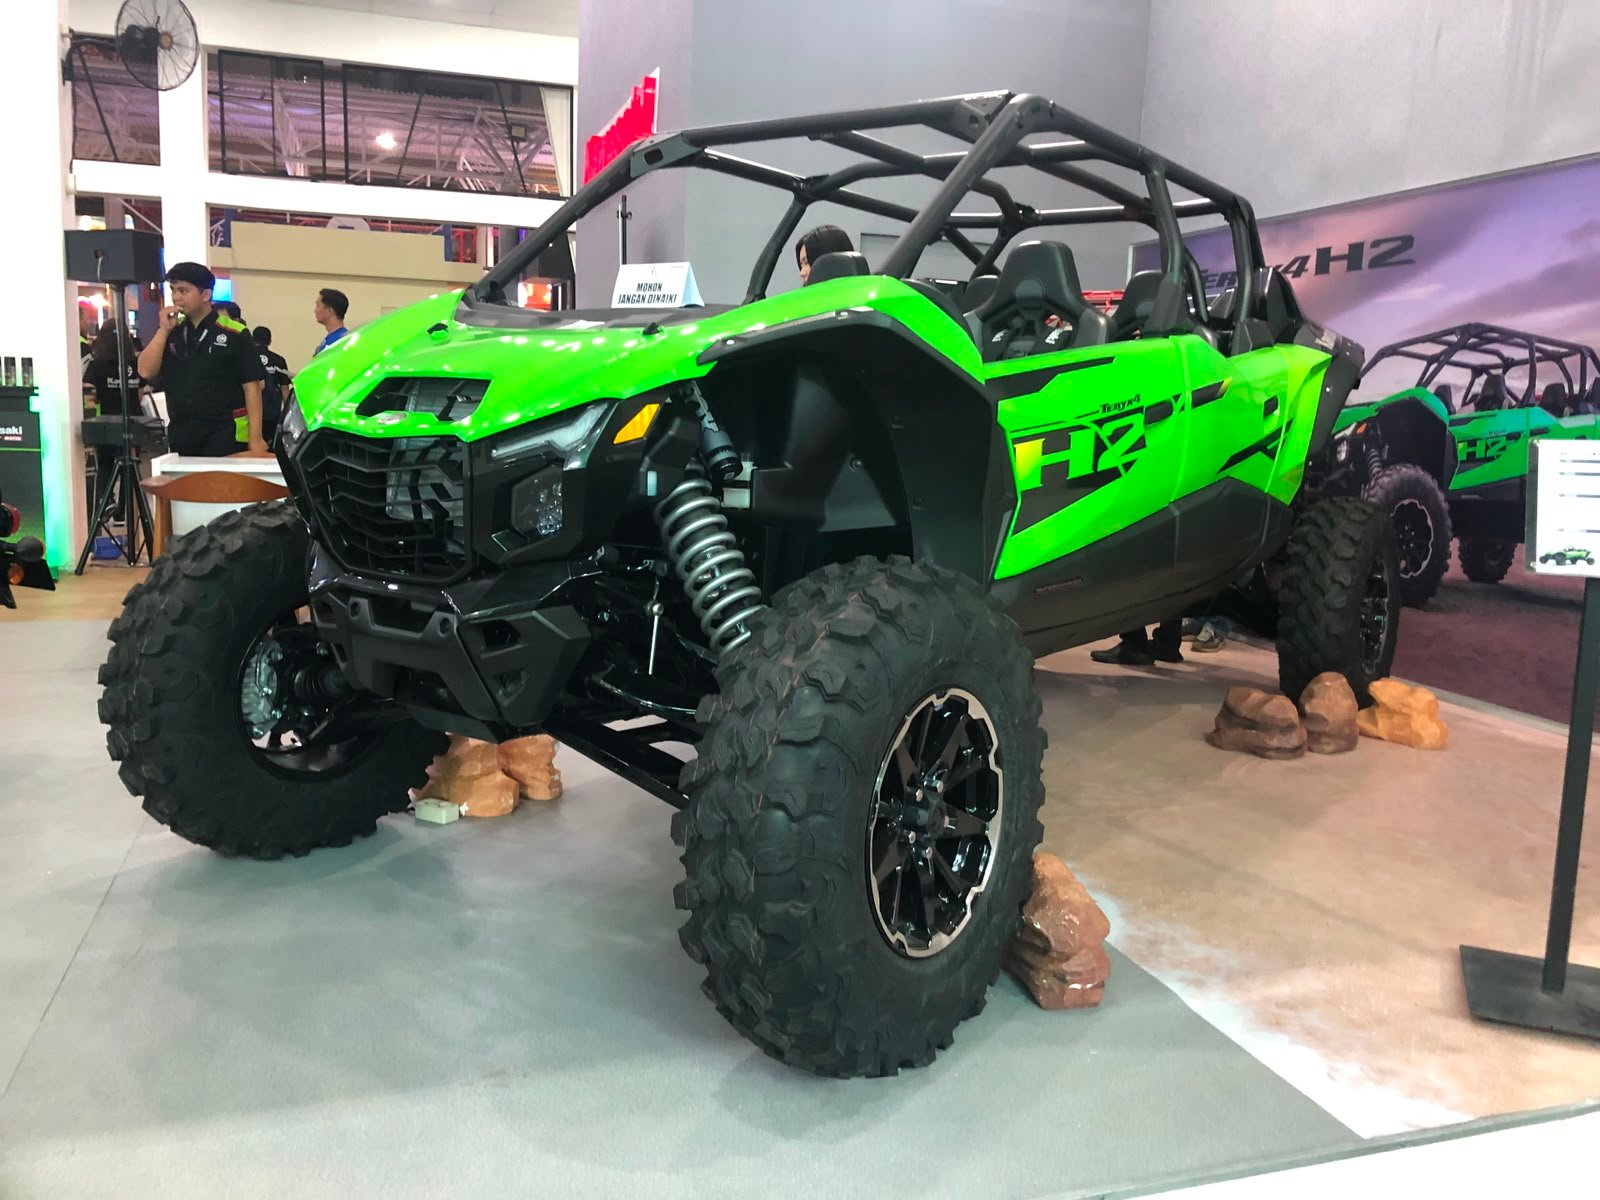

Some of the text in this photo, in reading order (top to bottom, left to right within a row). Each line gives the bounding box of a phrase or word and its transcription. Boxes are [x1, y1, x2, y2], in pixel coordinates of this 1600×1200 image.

[636, 282, 663, 292] MOHON
[618, 294, 677, 304] JANGAN DINAIKI
[0, 425, 22, 434] saki
[1013, 412, 1147, 492] H2
[1458, 437, 1507, 461] H2
